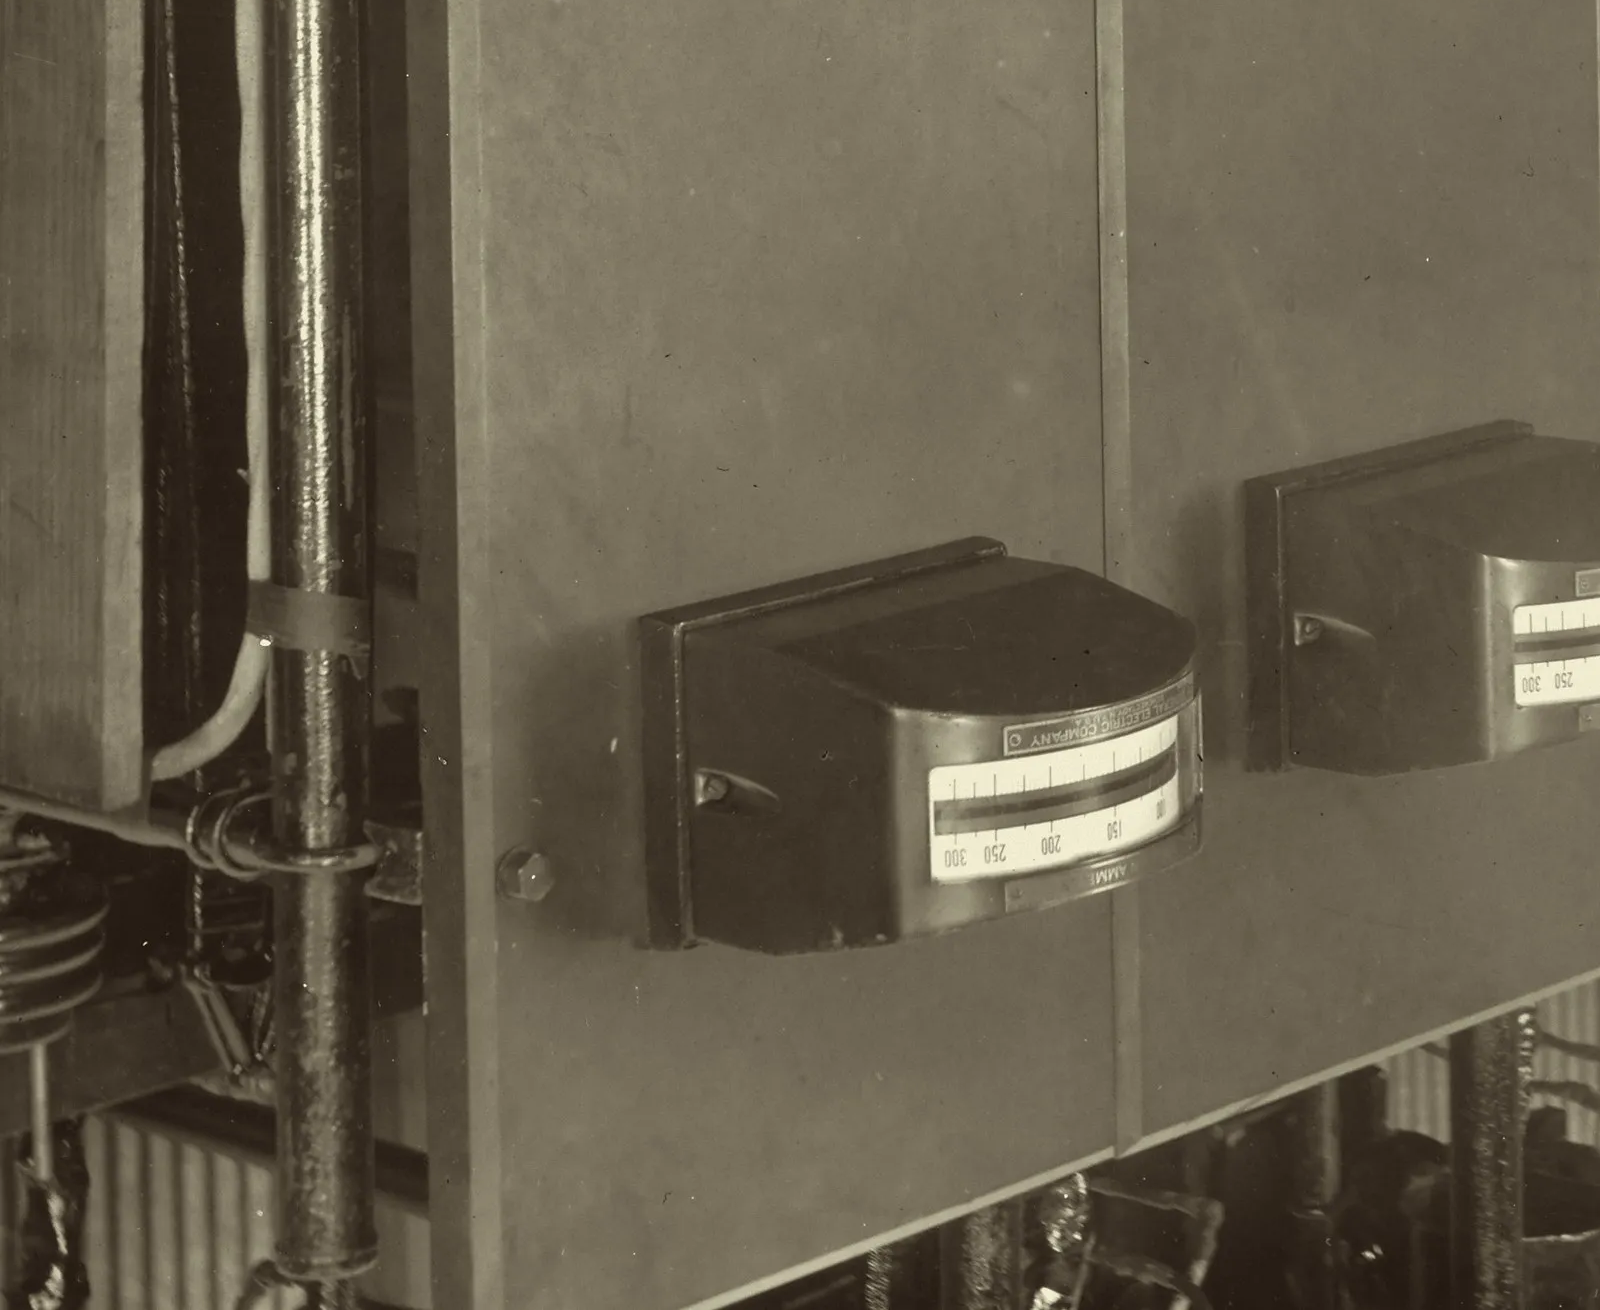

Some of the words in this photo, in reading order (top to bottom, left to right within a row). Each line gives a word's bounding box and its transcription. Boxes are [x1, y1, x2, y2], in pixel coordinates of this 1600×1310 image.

[1521, 674, 1540, 692] 300
[1553, 670, 1572, 688] 250
[1029, 722, 1096, 746] COMPANY
[1106, 818, 1122, 839] 150
[983, 843, 1005, 863] 250
[1040, 833, 1060, 854] 200
[944, 847, 966, 867] 300
